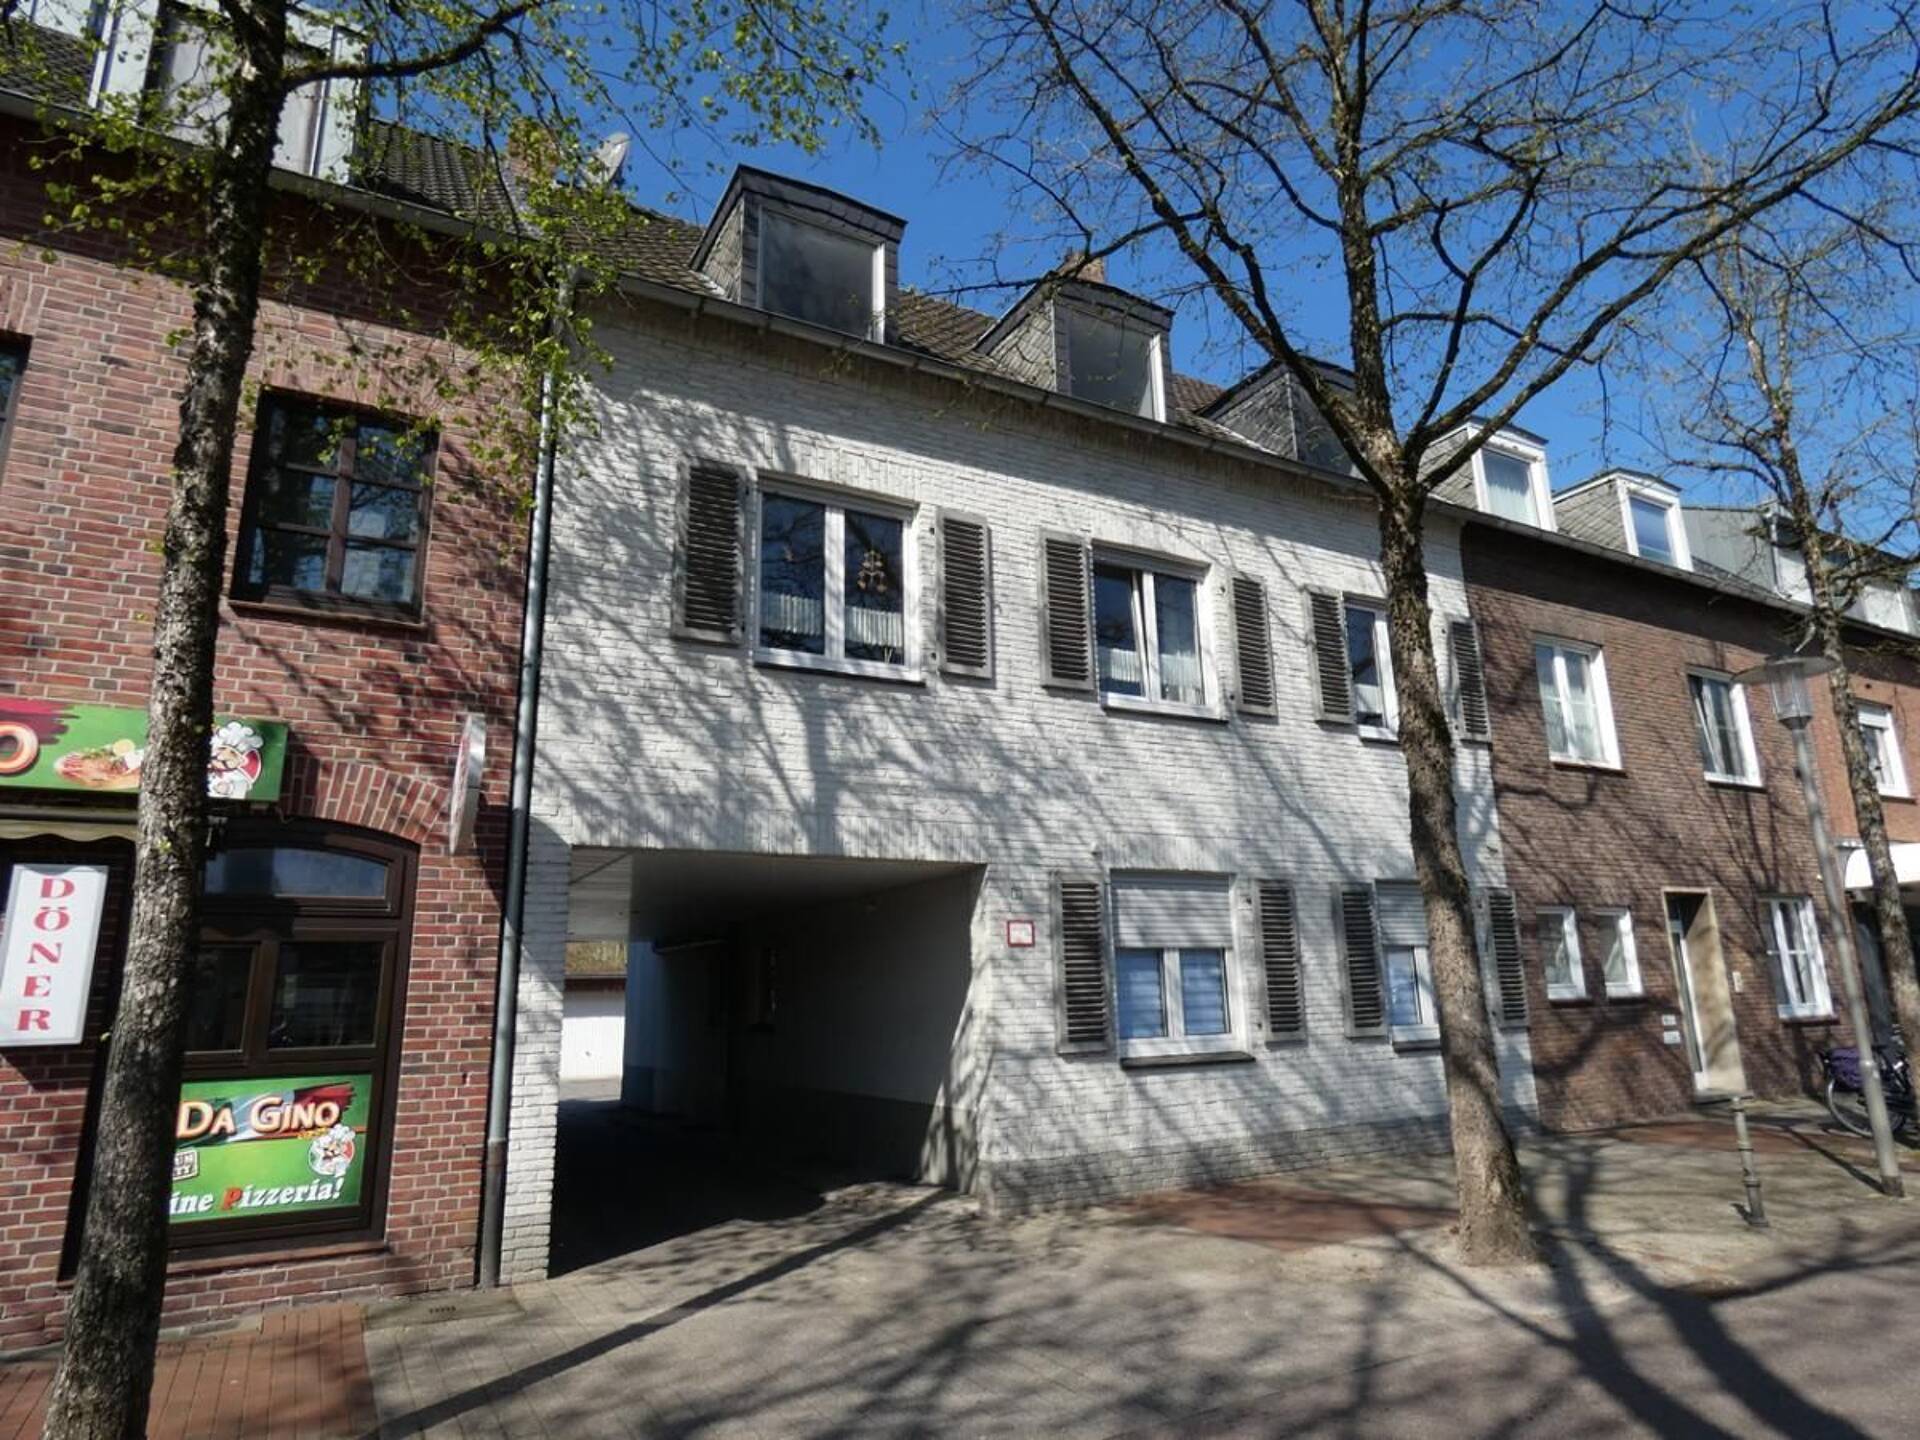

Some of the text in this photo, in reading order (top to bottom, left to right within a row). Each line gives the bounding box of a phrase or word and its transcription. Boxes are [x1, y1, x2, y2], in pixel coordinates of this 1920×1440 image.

[17, 877, 75, 1031] DÖNER
[169, 1177, 344, 1215] ine Pizzeria!
